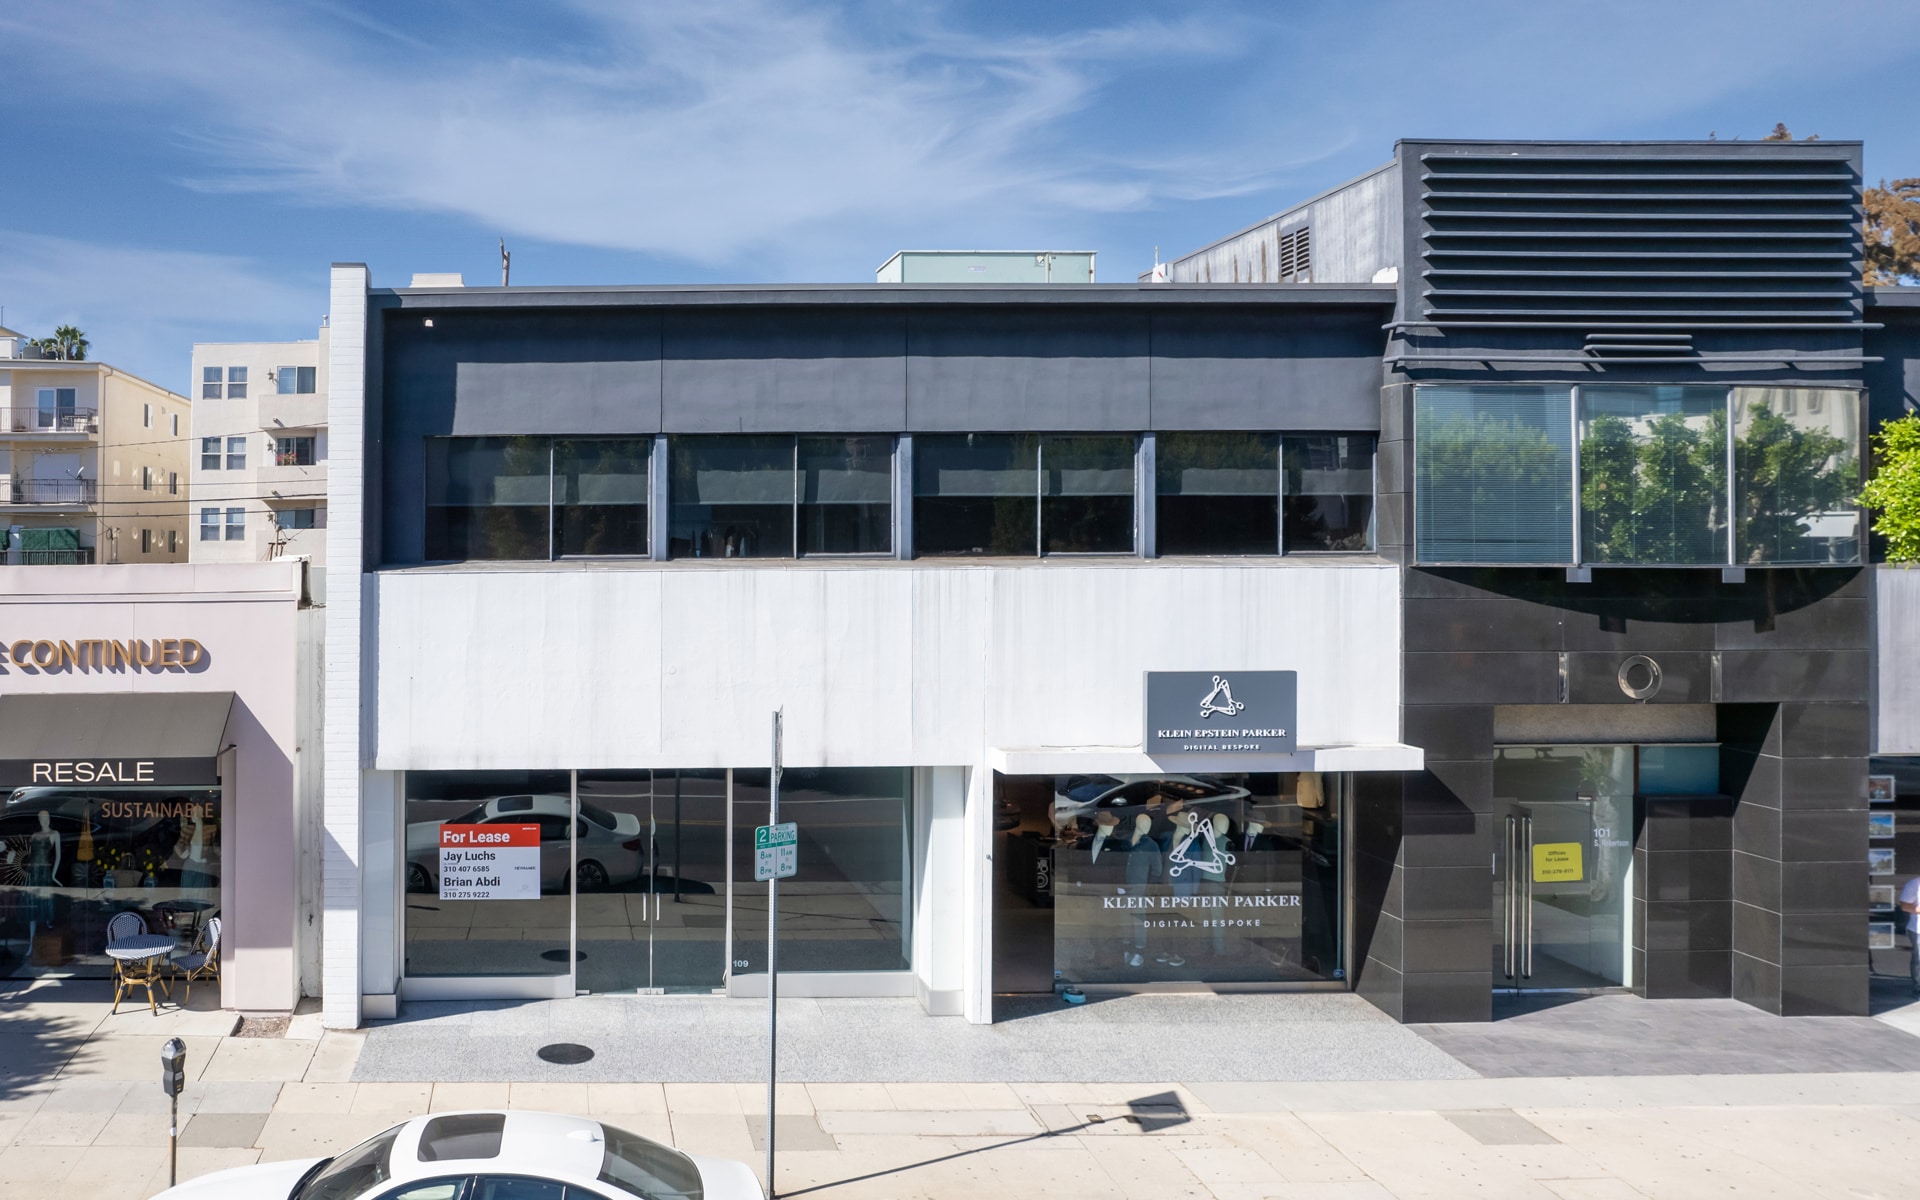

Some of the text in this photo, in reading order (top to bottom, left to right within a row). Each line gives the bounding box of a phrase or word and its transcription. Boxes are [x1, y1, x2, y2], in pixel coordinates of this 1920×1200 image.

[10, 638, 201, 667] CONTINUED
[1158, 728, 1286, 738] KLEIN EPSTEIN PARKER
[33, 761, 154, 783] RESALE
[101, 802, 214, 818] SUSTAINABLE
[443, 831, 510, 843] For Lease
[759, 828, 767, 843] 2
[770, 829, 795, 843] PARKING
[1593, 827, 1610, 838] 101
[444, 850, 496, 863] Jay Luchs
[444, 876, 501, 887] Brian Abdi
[1103, 895, 1301, 909] KLEIN EPSTEIN PARKER
[1143, 919, 1261, 928] DIGITAL BESPOKE
[732, 960, 749, 968] 109
